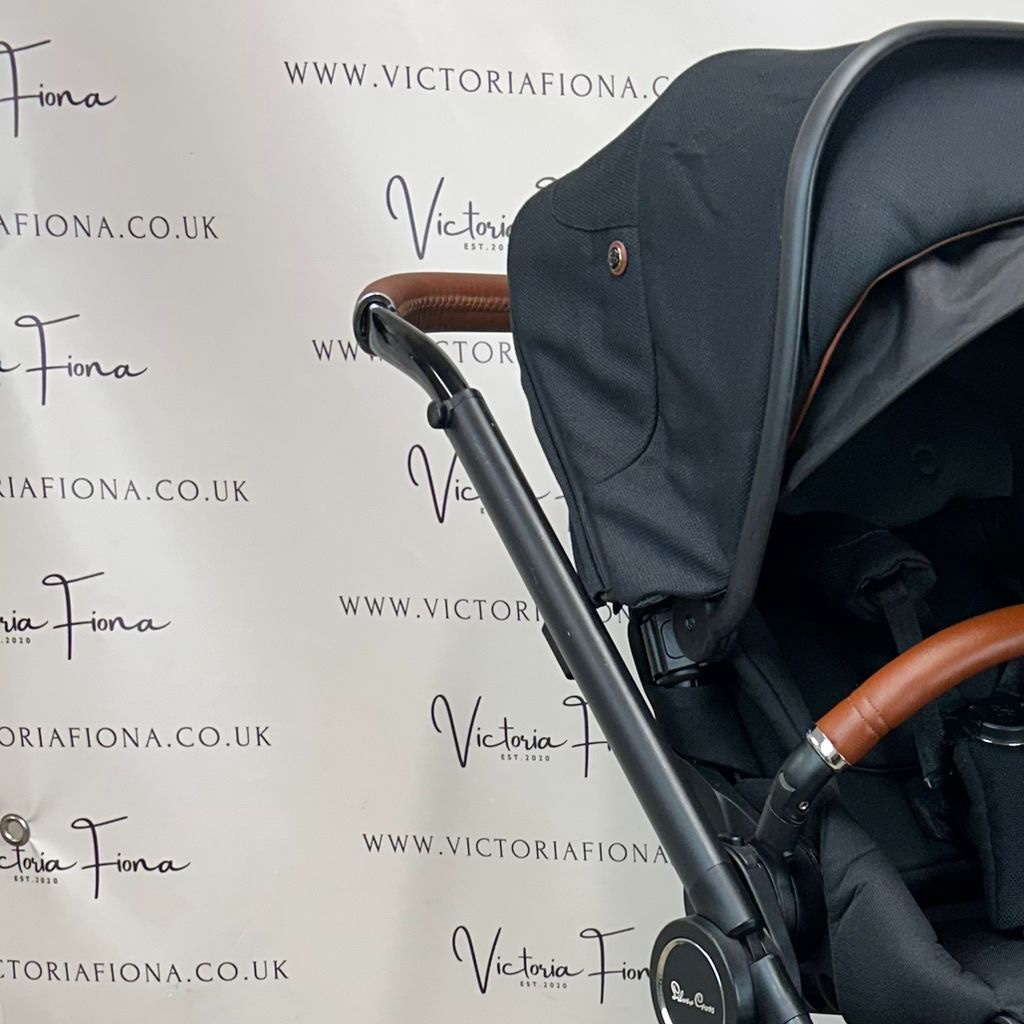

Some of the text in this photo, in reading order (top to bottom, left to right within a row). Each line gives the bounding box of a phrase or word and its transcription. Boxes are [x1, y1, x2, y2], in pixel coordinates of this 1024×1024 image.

[14, 314, 148, 406] Fiona
[0, 476, 249, 502] IAFIONA.CO.UK
[42, 571, 171, 660] Fiona
[431, 694, 567, 768] Victoria
[500, 753, 550, 763] EST.2020
[13, 874, 59, 885] EST.2020
[71, 816, 190, 900] Fiona
[0, 959, 289, 983] TORIAFIONA.CO.UK
[453, 925, 584, 994] Victoria
[520, 980, 568, 989] EST.2020
